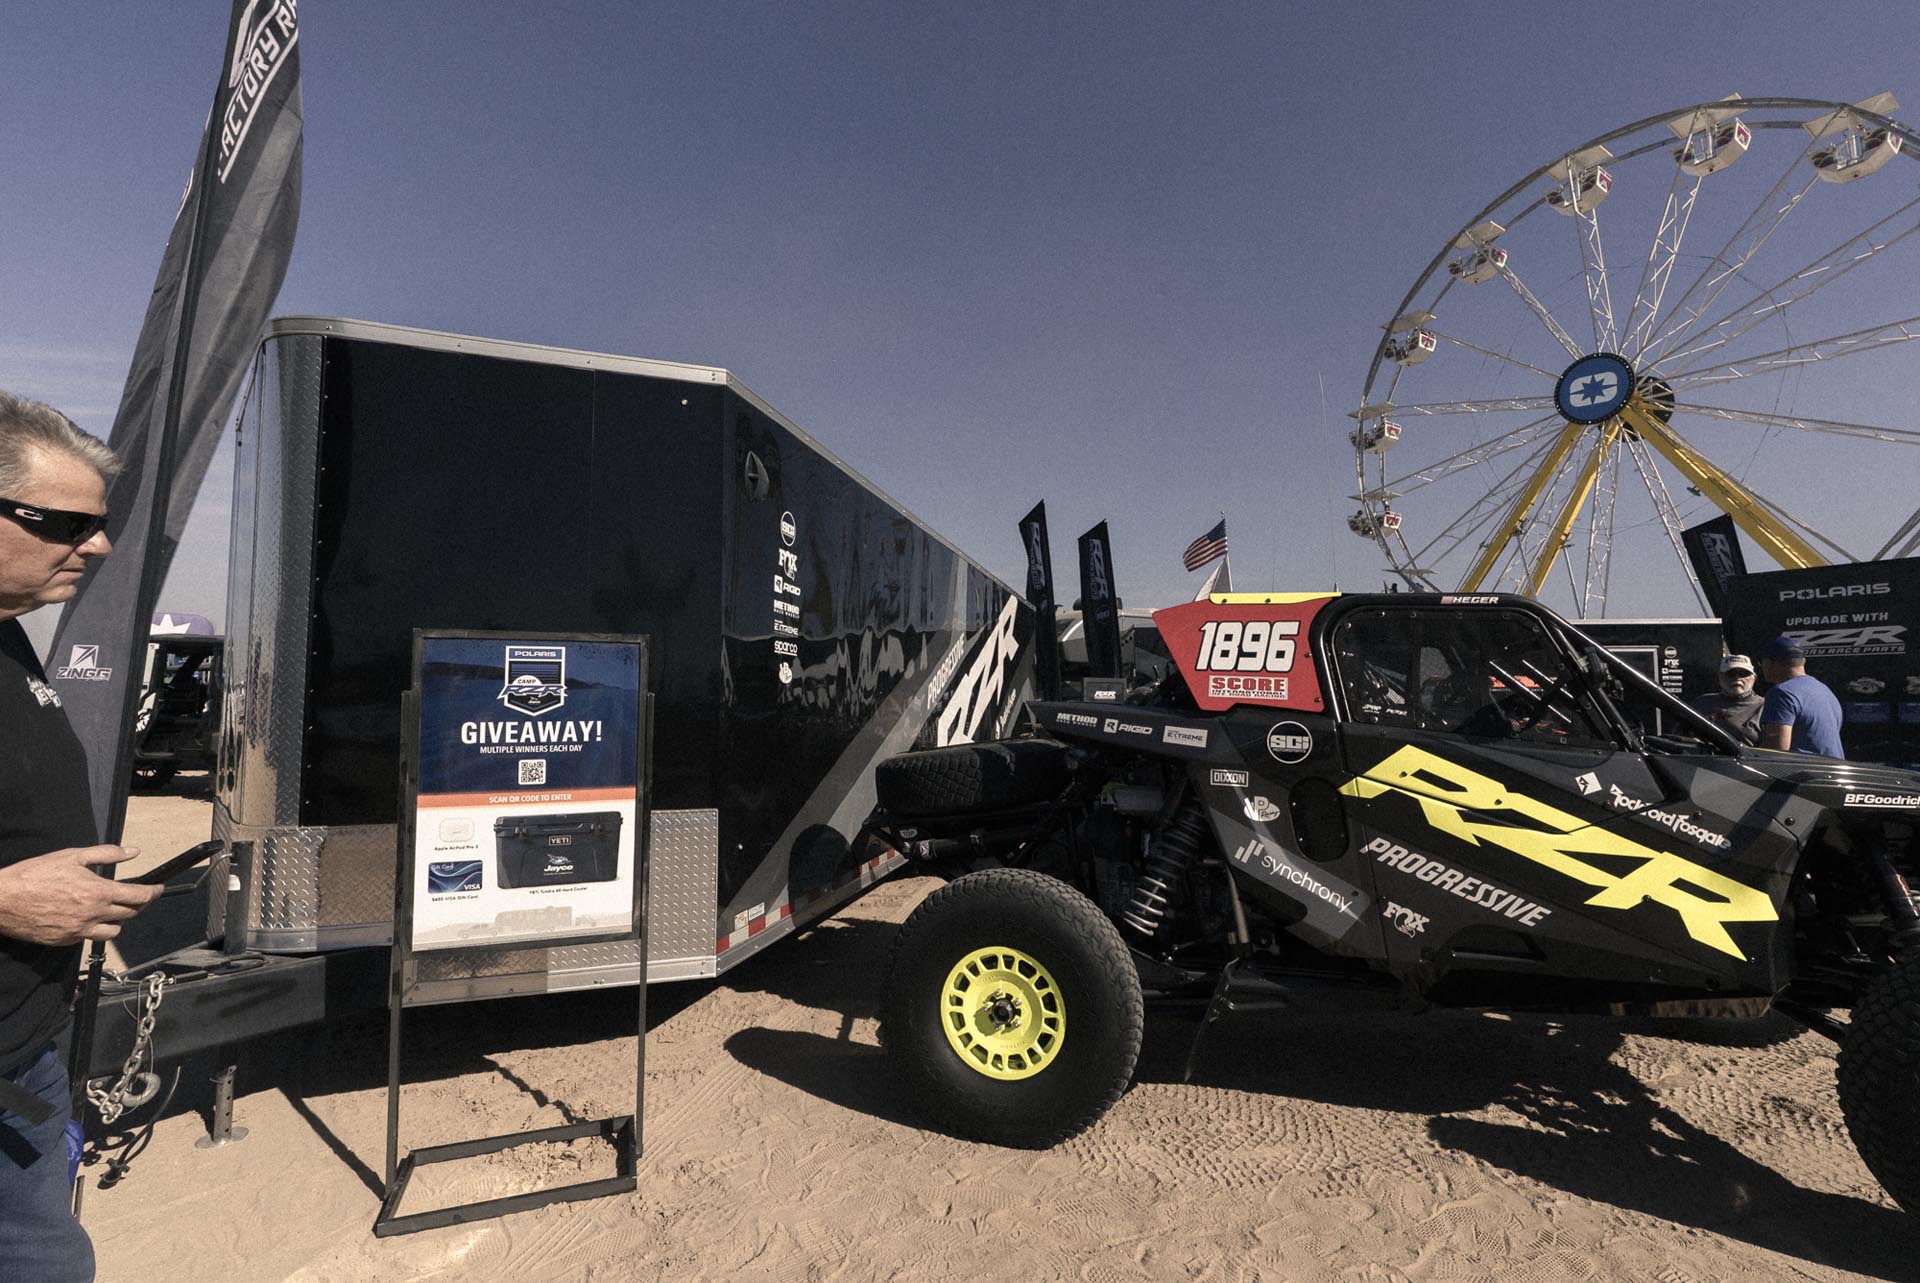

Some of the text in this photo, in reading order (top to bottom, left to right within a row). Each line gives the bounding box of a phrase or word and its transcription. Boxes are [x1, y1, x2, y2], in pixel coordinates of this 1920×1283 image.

[218, 28, 281, 177] ACTORY
[779, 548, 798, 572] FOX
[783, 582, 801, 596] RIGID
[1779, 583, 1891, 601] POLARIS
[773, 599, 800, 615] METHOD
[1453, 596, 1500, 604] HEGER
[1786, 612, 1889, 626] UPGRADE WITH
[1781, 625, 1908, 647] RZR
[774, 640, 798, 655] sparco
[1195, 620, 1301, 672] 1896
[1863, 645, 1905, 653] PARTS
[56, 667, 112, 681] ZINGG
[927, 632, 965, 710] PROGRESSIVE
[497, 684, 568, 699] RZR
[1212, 677, 1285, 692] SCORE
[1056, 712, 1098, 724] METHOD
[461, 720, 602, 744] GIVEAWAY!
[1118, 723, 1153, 735] RIGID
[480, 744, 583, 754] MULTIPLE WINNERS EACH DAY
[1213, 772, 1246, 784] DIXXON
[489, 795, 508, 804] SCAN
[509, 795, 520, 803] QR
[521, 794, 539, 802] CODE
[551, 793, 572, 801] ENTER
[1338, 744, 1780, 962] RZR
[543, 864, 574, 872] Jayco
[464, 883, 481, 891] VISA
[1261, 855, 1353, 913] synchrony
[1359, 837, 1552, 927] PROGRESSIVE
[1383, 901, 1431, 933] FOX
